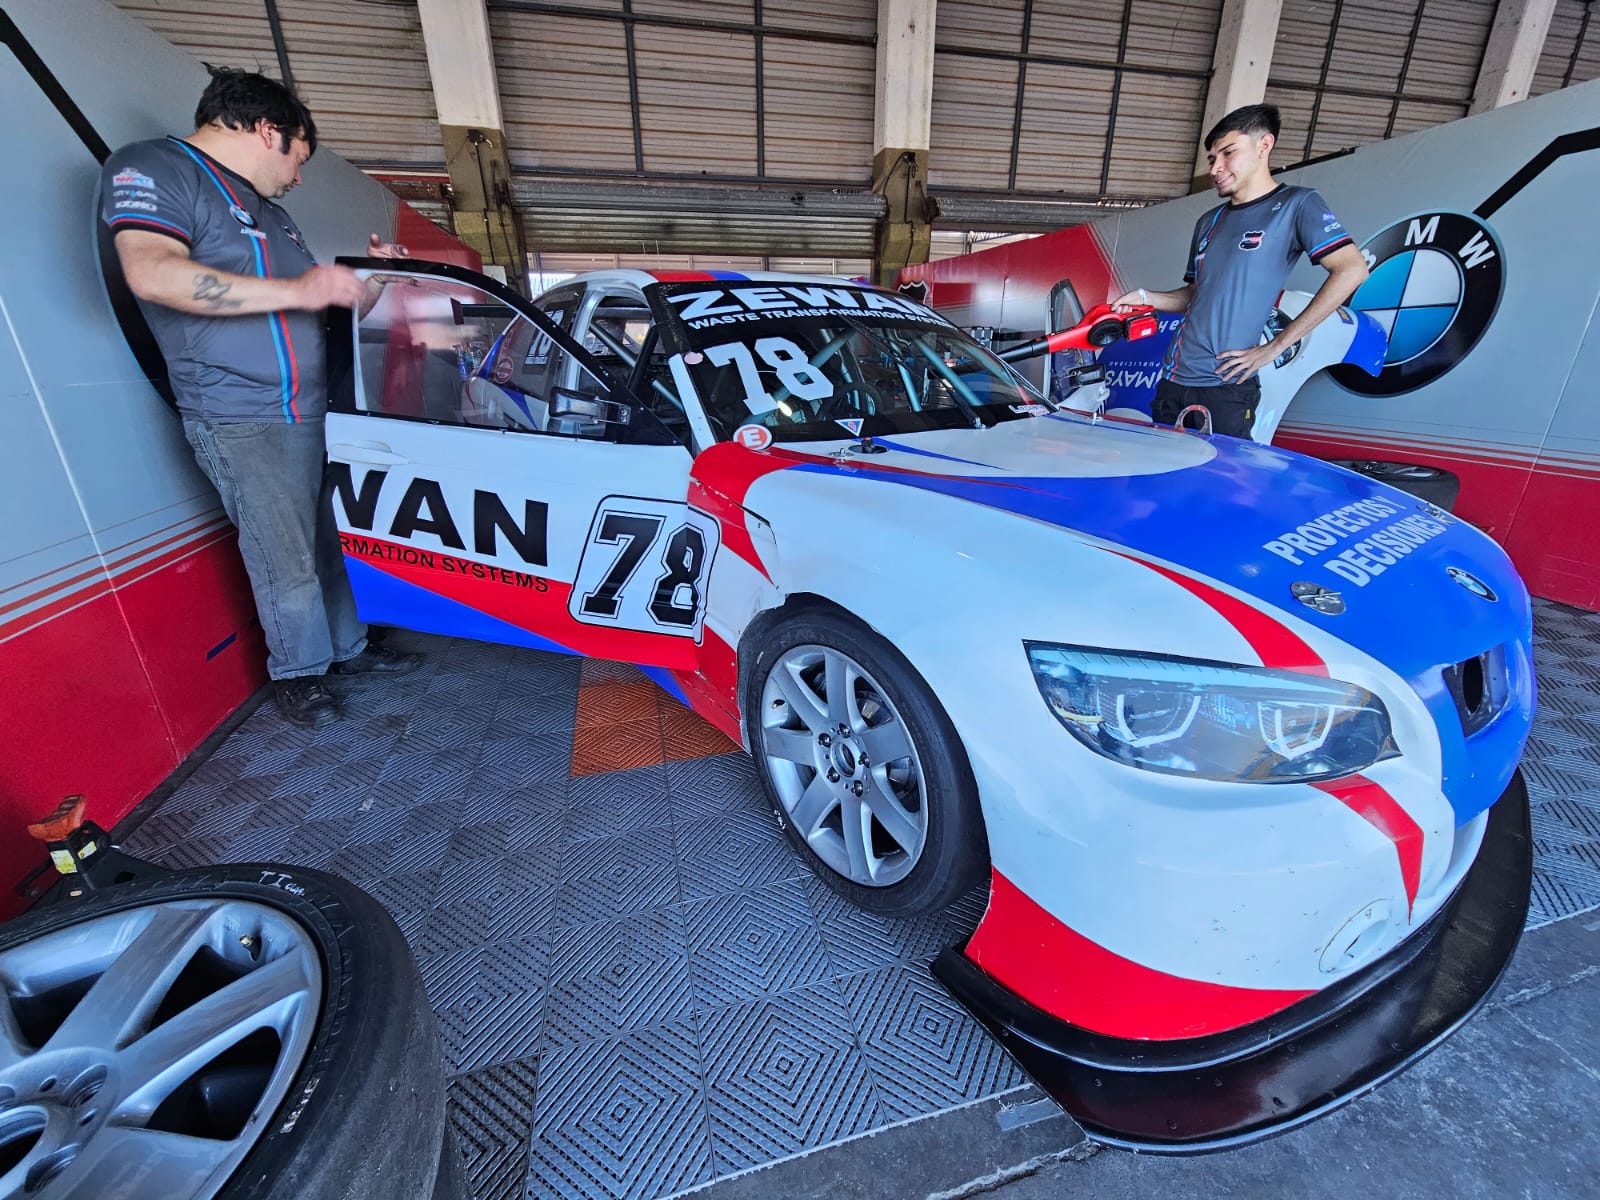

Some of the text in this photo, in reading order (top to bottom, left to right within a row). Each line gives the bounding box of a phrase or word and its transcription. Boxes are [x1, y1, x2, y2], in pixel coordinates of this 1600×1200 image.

[667, 286, 949, 322] ZEWAN
[688, 311, 759, 330] WASTE
[760, 309, 905, 320] TRANSFORMATION
[703, 336, 834, 416] 78
[1262, 499, 1398, 566] PROYECTOS
[1323, 514, 1448, 587] DECISIONES
[442, 557, 549, 593] SYSTEMS
[579, 509, 708, 630] 78
